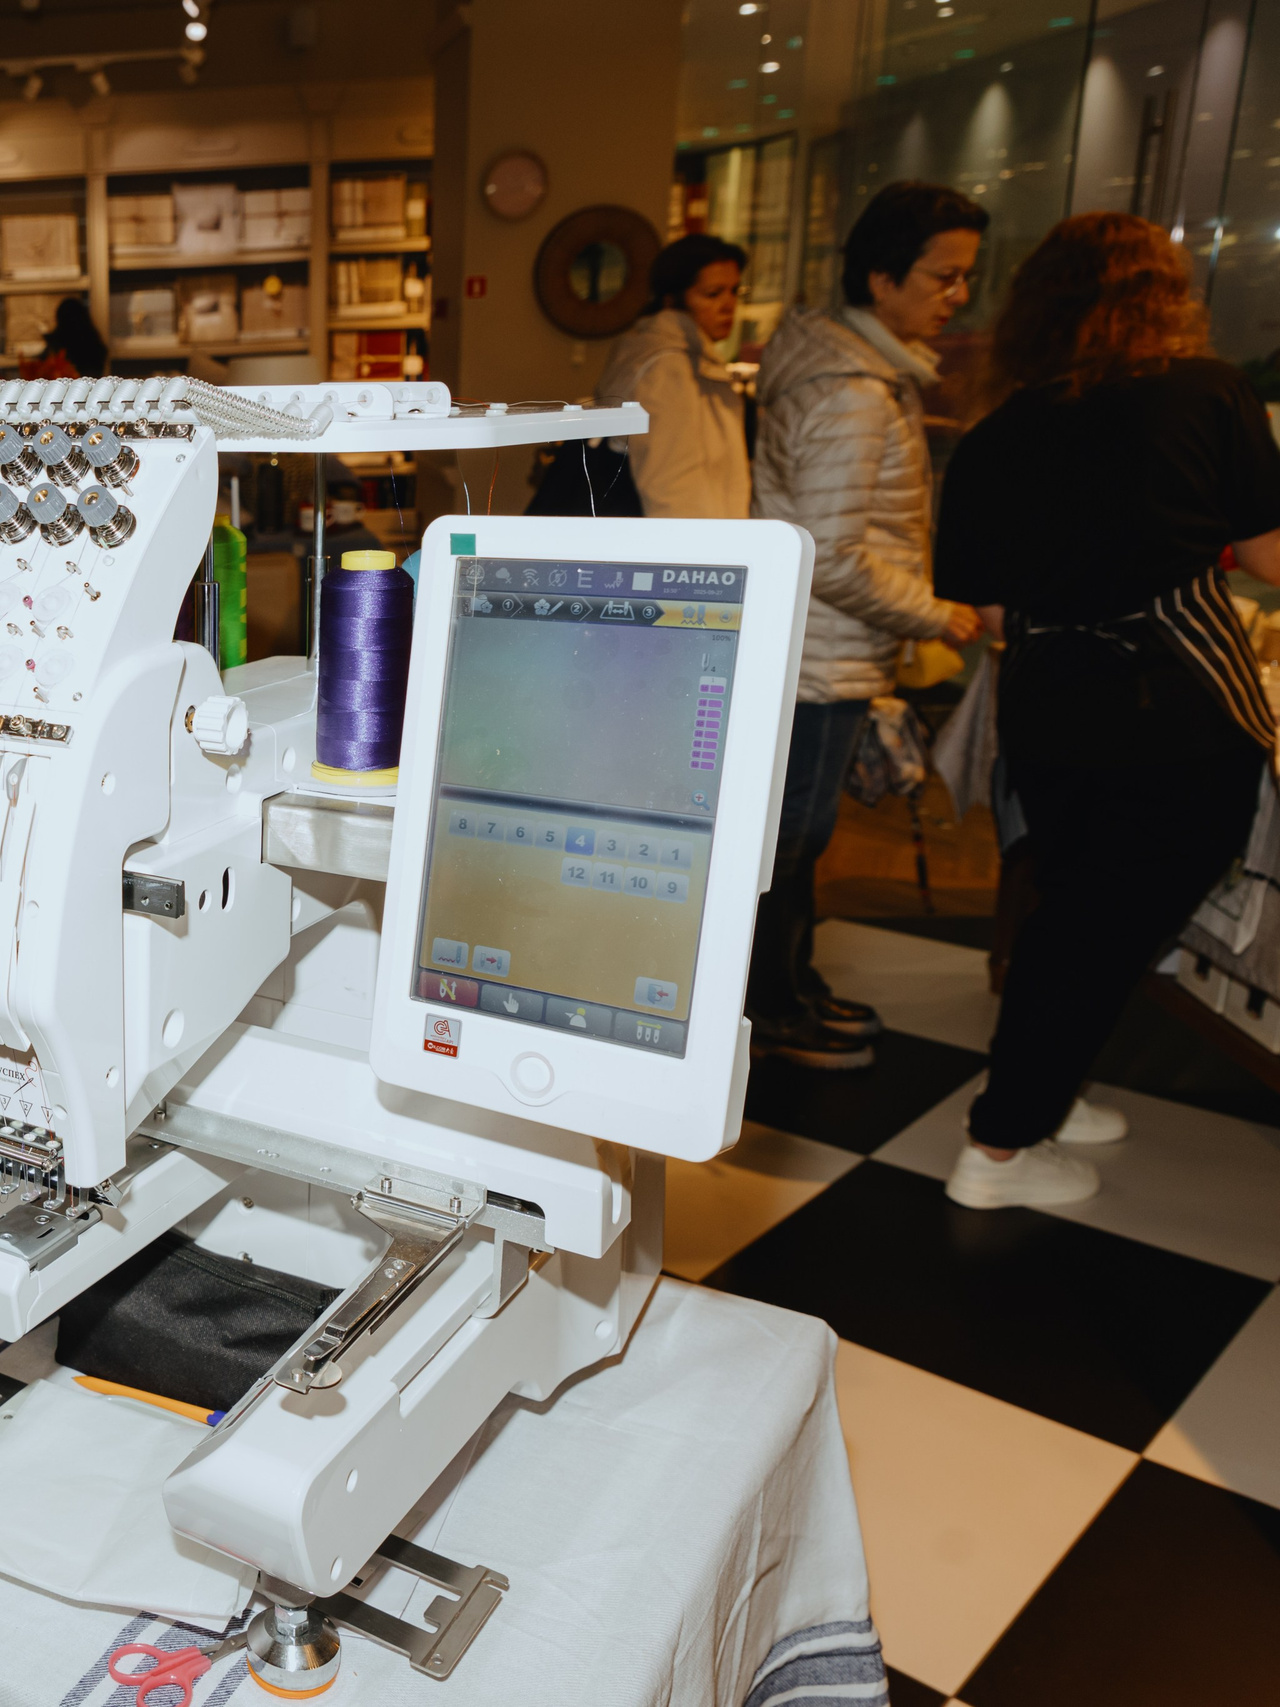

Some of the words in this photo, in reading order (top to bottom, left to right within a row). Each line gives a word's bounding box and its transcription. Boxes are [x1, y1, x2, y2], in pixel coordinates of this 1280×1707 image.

[662, 569, 736, 586] DAHAO
[712, 634, 732, 642] 100%
[458, 818, 468, 830] 8
[487, 822, 497, 834] 7
[516, 826, 525, 838] 6
[545, 831, 555, 842] 5
[575, 834, 586, 847] 4
[606, 839, 617, 851] 3
[639, 843, 649, 856] 2
[672, 848, 680, 861] 1
[567, 866, 585, 879] 12
[599, 871, 615, 884] 11
[630, 875, 648, 889] 10
[667, 881, 678, 894] 9
